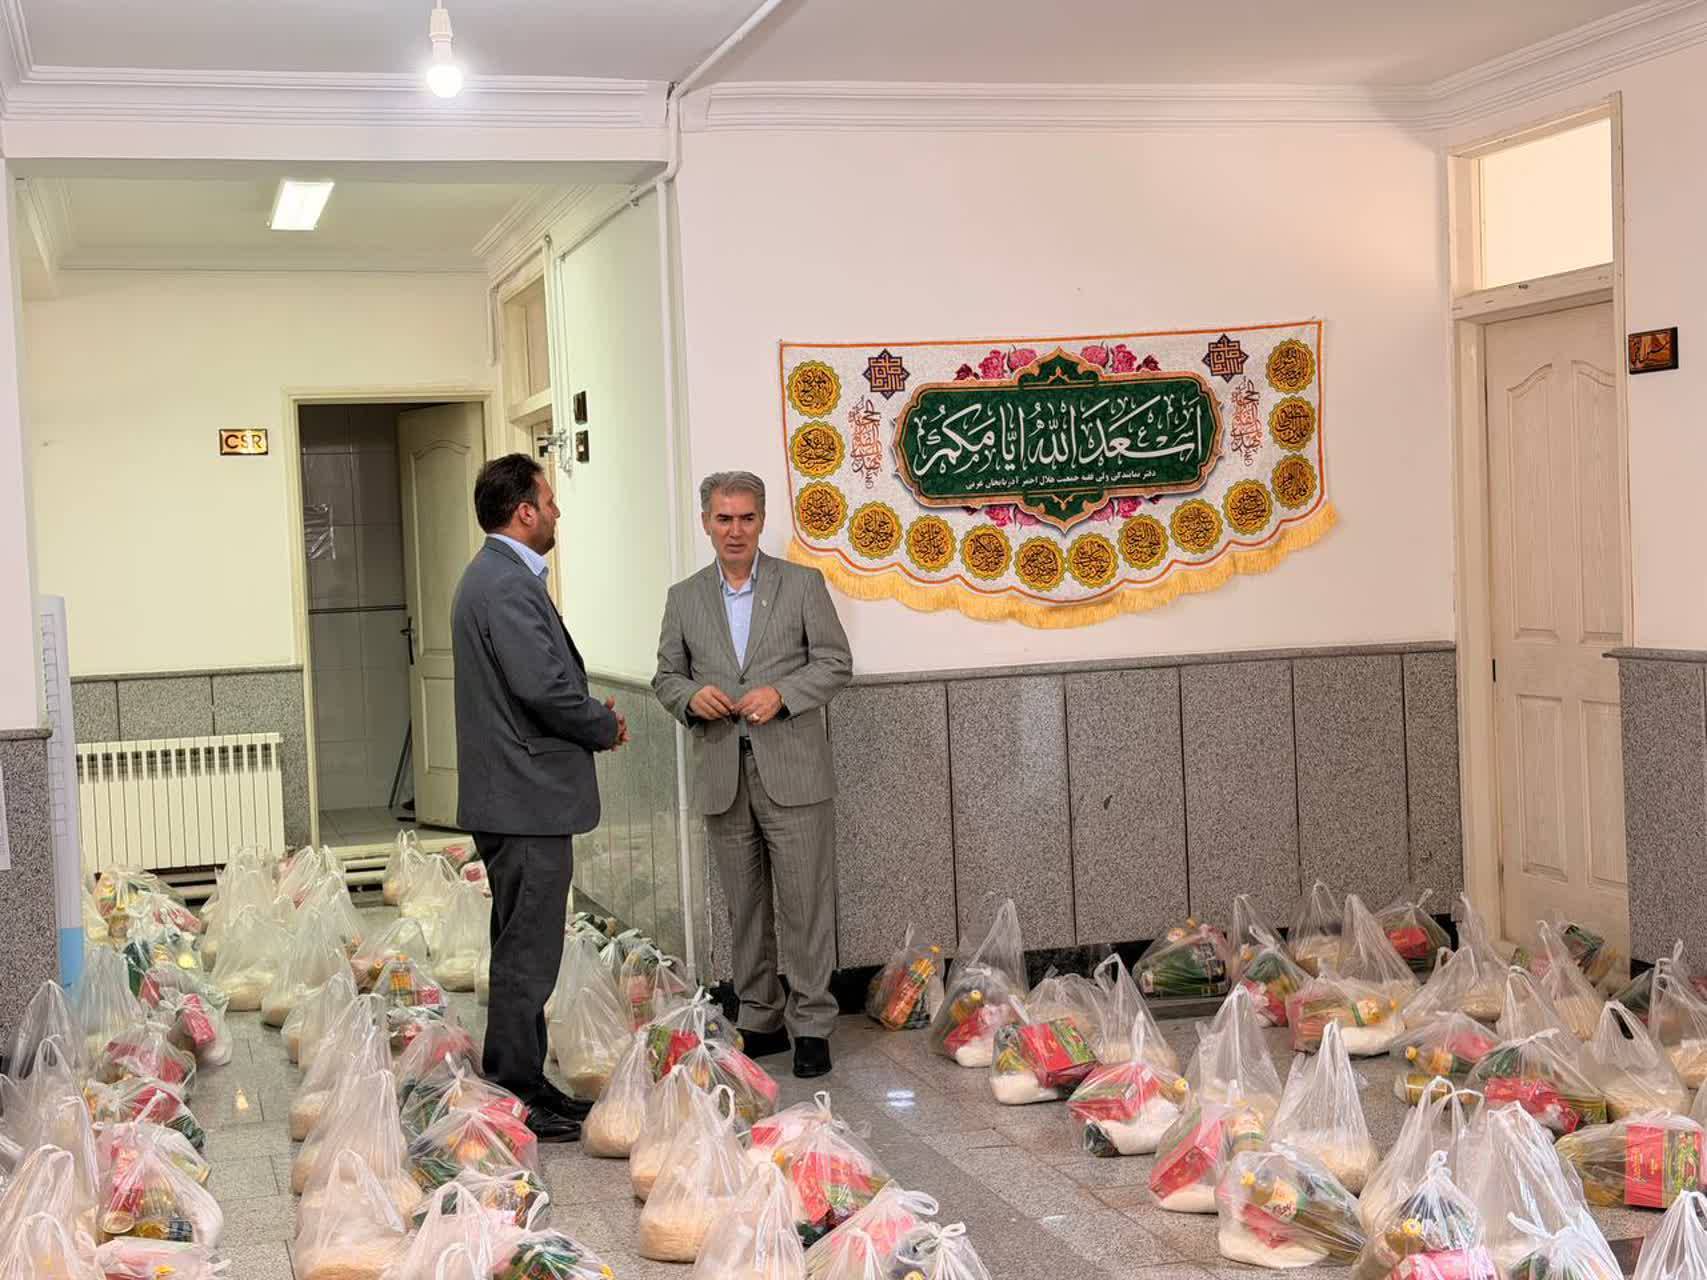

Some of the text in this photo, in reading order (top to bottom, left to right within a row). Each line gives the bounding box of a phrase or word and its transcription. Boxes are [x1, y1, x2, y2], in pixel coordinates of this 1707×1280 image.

[224, 433, 263, 450] CSR
[1095, 472, 1109, 483] ولی
[1142, 469, 1157, 480] دفتر
[1021, 476, 1039, 488] احمر
[1039, 475, 1055, 486] هلال
